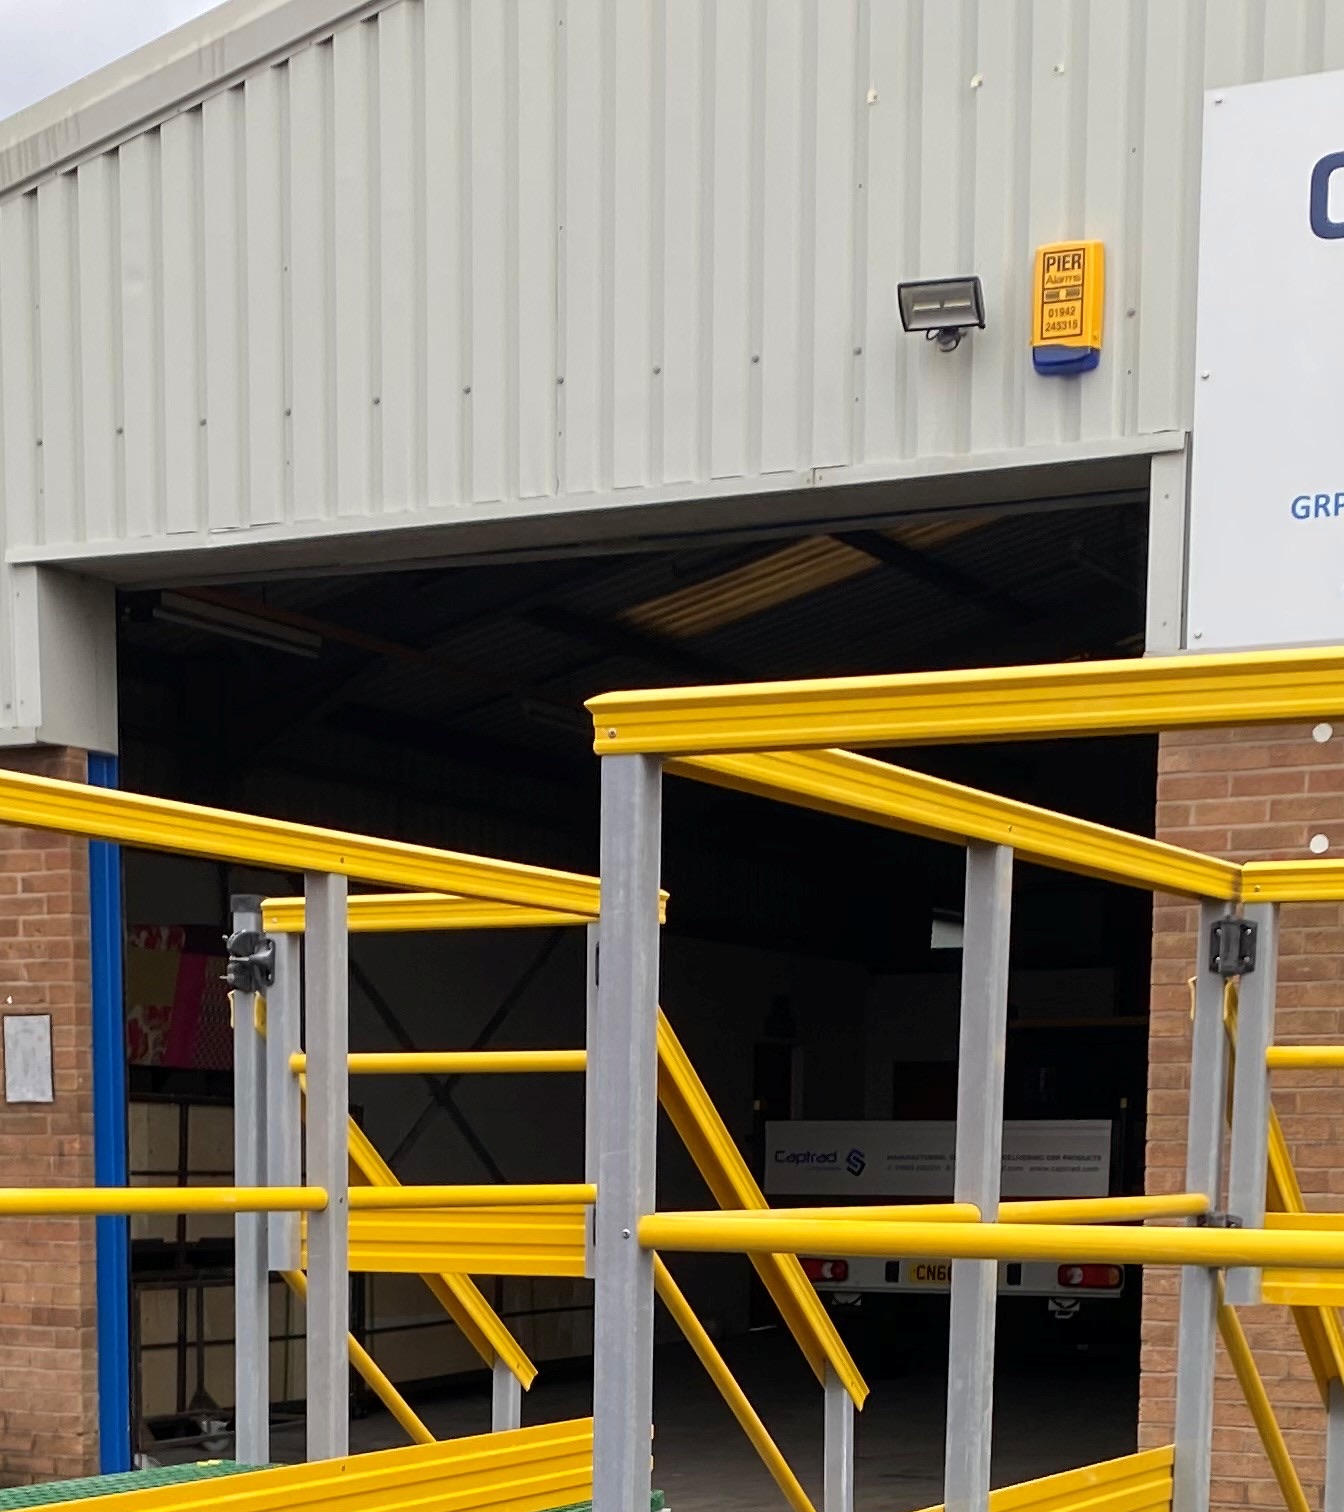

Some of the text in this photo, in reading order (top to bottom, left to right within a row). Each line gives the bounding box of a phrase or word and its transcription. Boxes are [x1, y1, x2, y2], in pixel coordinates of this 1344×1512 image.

[1046, 253, 1082, 273] PIER
[1048, 305, 1076, 318] 01942
[774, 1150, 838, 1165] Captrad
